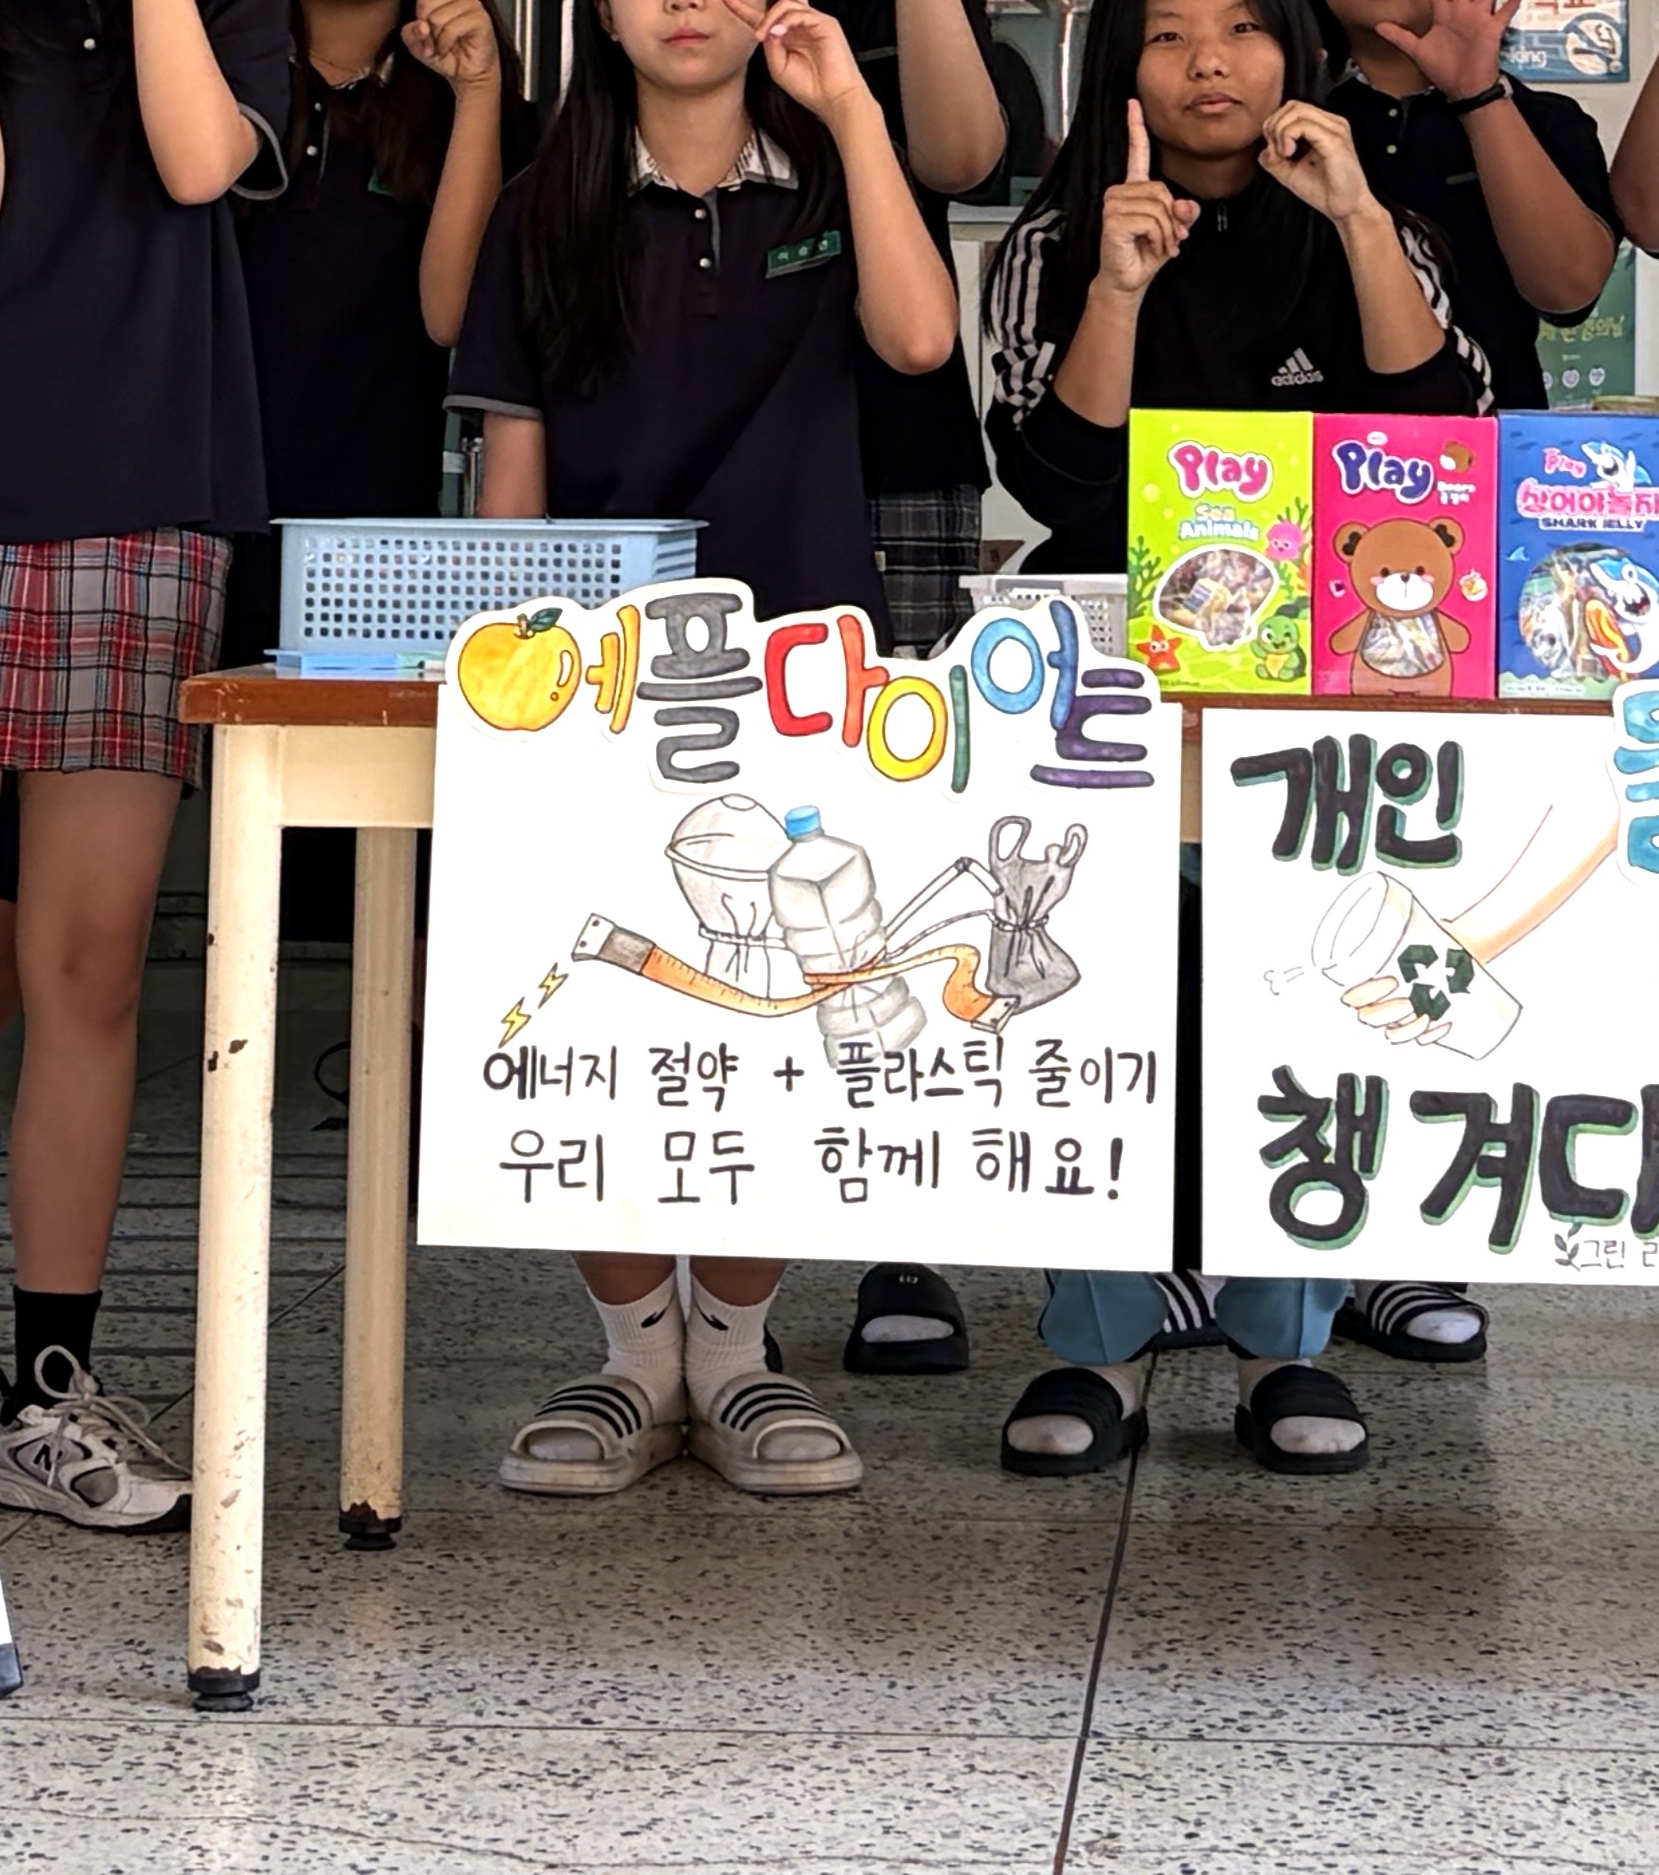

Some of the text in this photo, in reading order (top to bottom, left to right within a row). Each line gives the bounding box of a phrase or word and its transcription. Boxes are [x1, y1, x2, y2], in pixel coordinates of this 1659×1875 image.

[1271, 370, 1324, 386] adidas
[1171, 443, 1270, 497] Play
[1335, 441, 1433, 500] Play
[1544, 451, 1585, 477] Play
[1179, 520, 1260, 541] Animals
[1541, 517, 1598, 529] SHARK
[1229, 732, 1464, 875] 개인
[483, 1045, 619, 1100] 에너지
[650, 1043, 740, 1111] 절약
[835, 1041, 1004, 1109] 플라스틱
[1028, 1039, 1157, 1107] 줄이기
[500, 1128, 605, 1204] 우리
[657, 1130, 755, 1205] 모두
[813, 1127, 941, 1204] 함께
[1580, 1240, 1626, 1269] 그린
